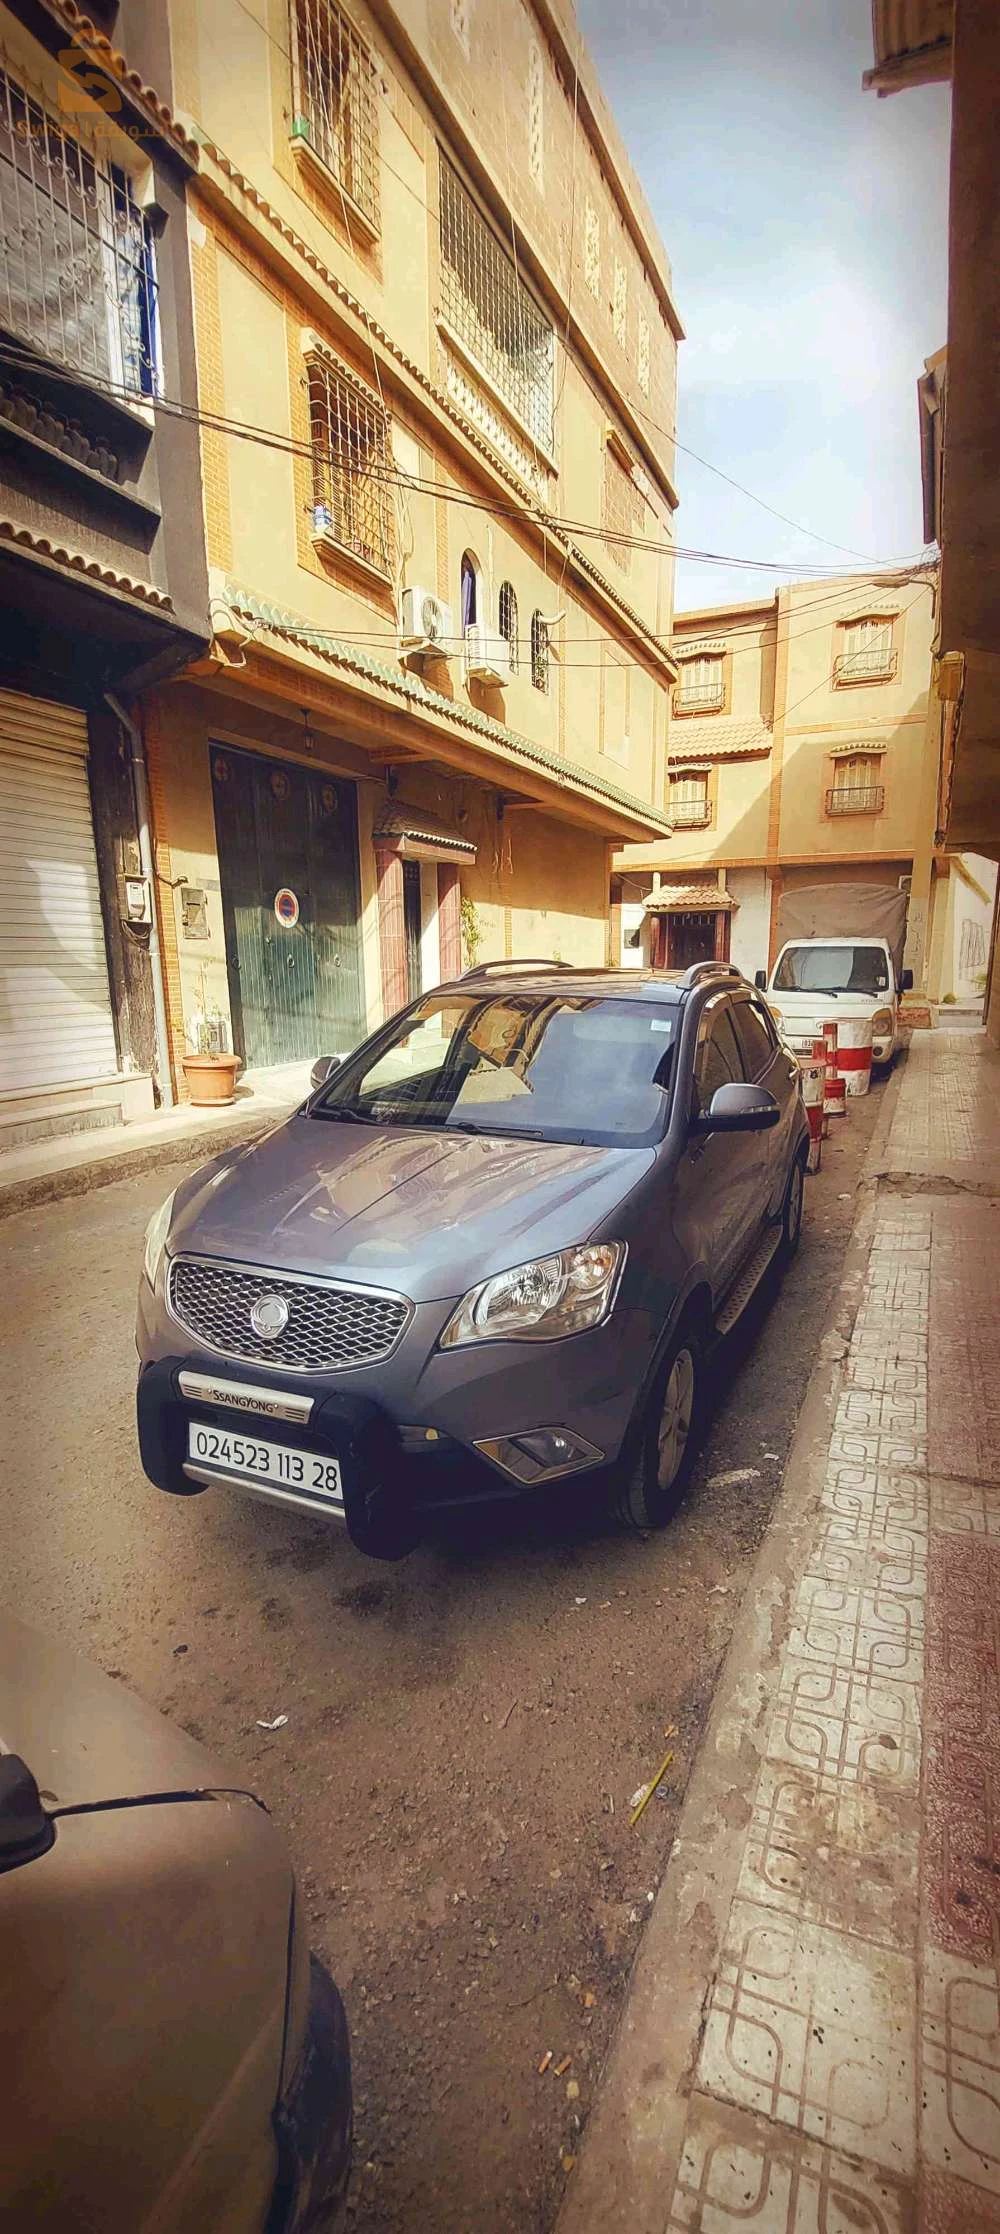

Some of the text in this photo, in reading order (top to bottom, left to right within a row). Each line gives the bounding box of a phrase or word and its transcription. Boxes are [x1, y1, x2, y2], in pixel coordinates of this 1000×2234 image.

[196, 1431, 338, 1491] 024523 113 28
